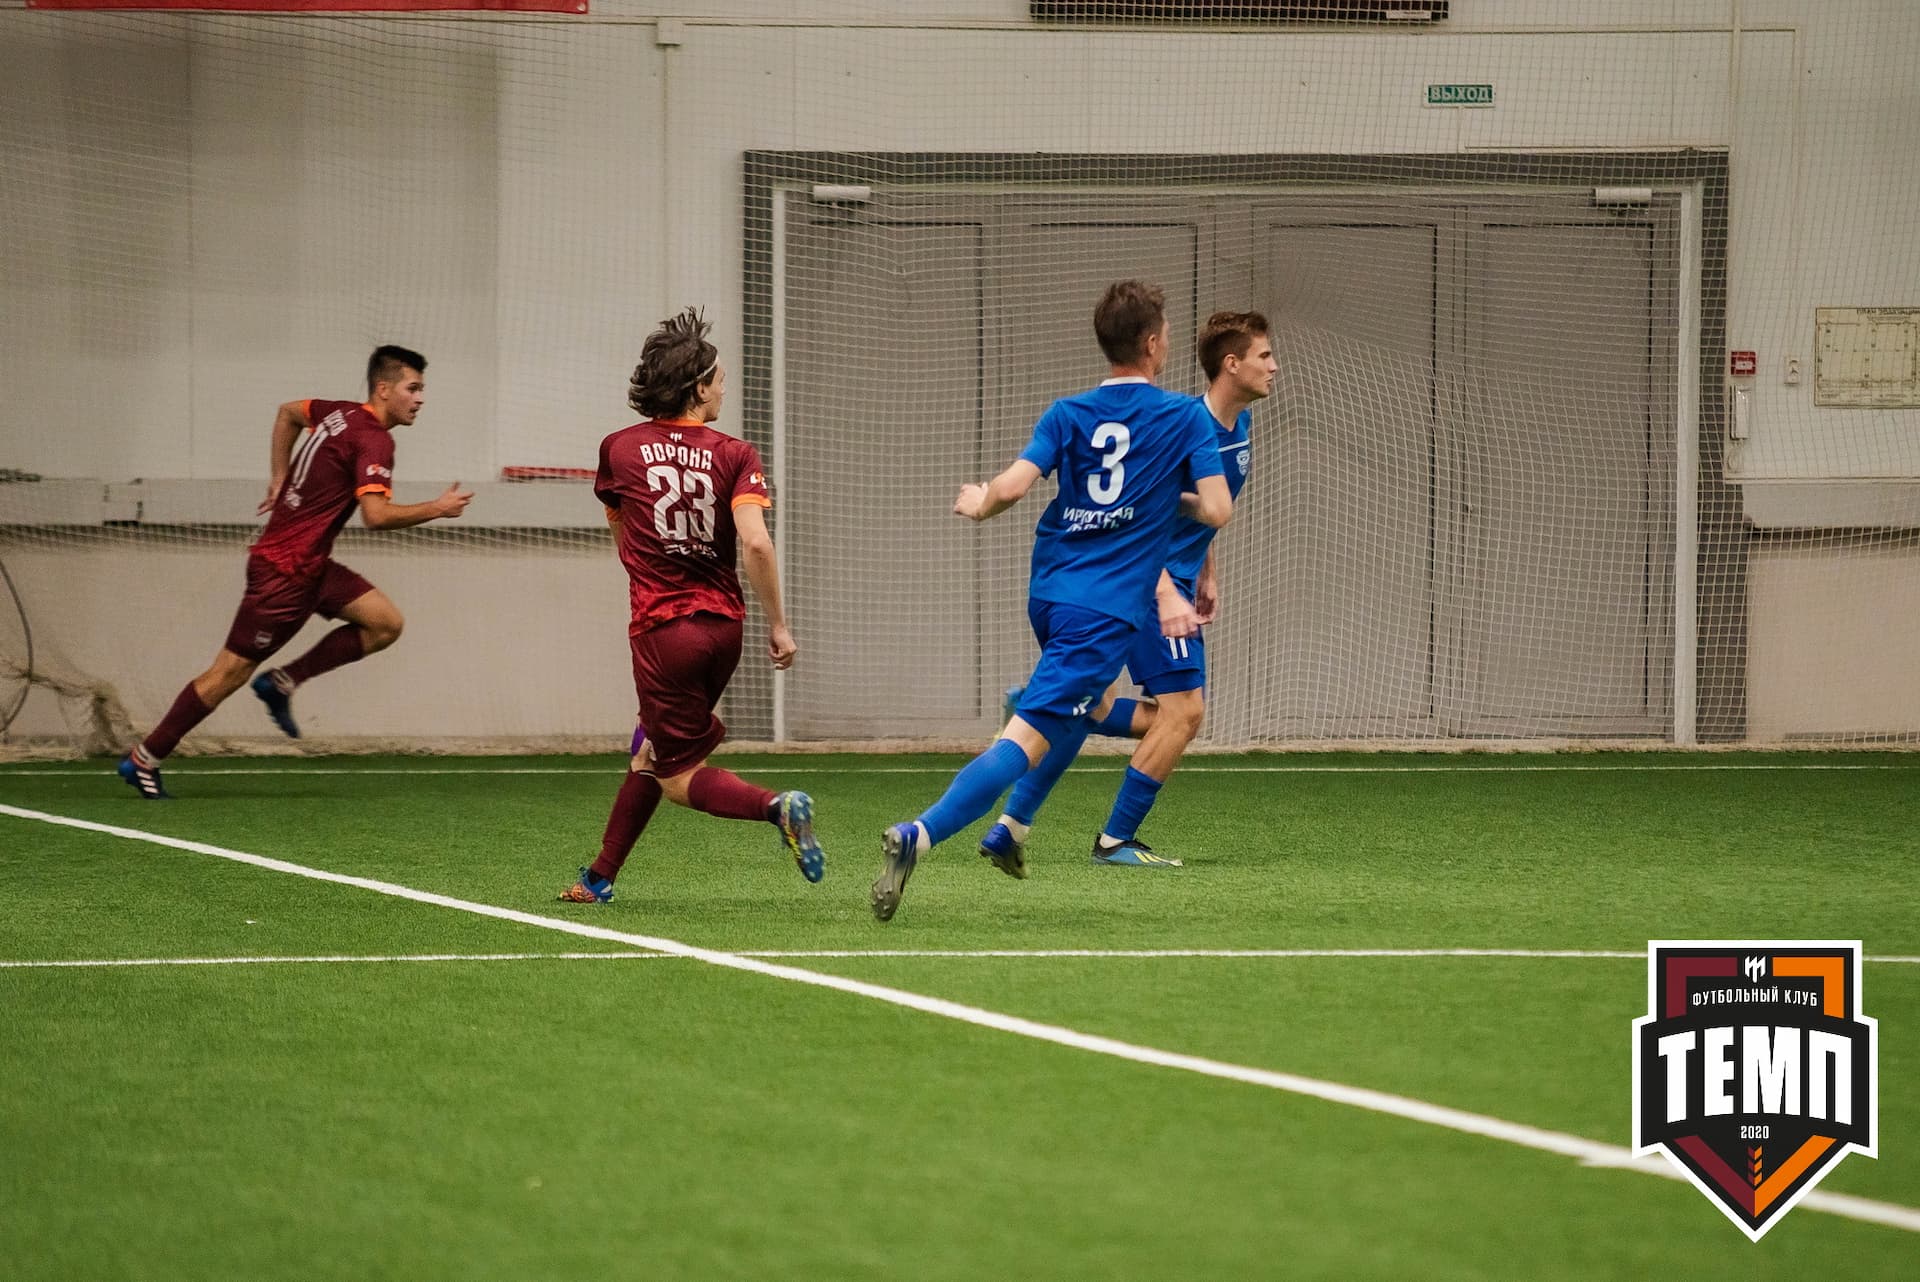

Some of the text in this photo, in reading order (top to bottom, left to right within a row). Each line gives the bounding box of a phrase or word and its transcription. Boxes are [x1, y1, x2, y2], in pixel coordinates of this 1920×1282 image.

[1429, 86, 1490, 101] ВЫХОД
[640, 443, 713, 471] ВОРОНА
[1087, 422, 1131, 505] 3
[646, 465, 717, 543] 23
[1063, 506, 1134, 526] ИРКУТСАЯ
